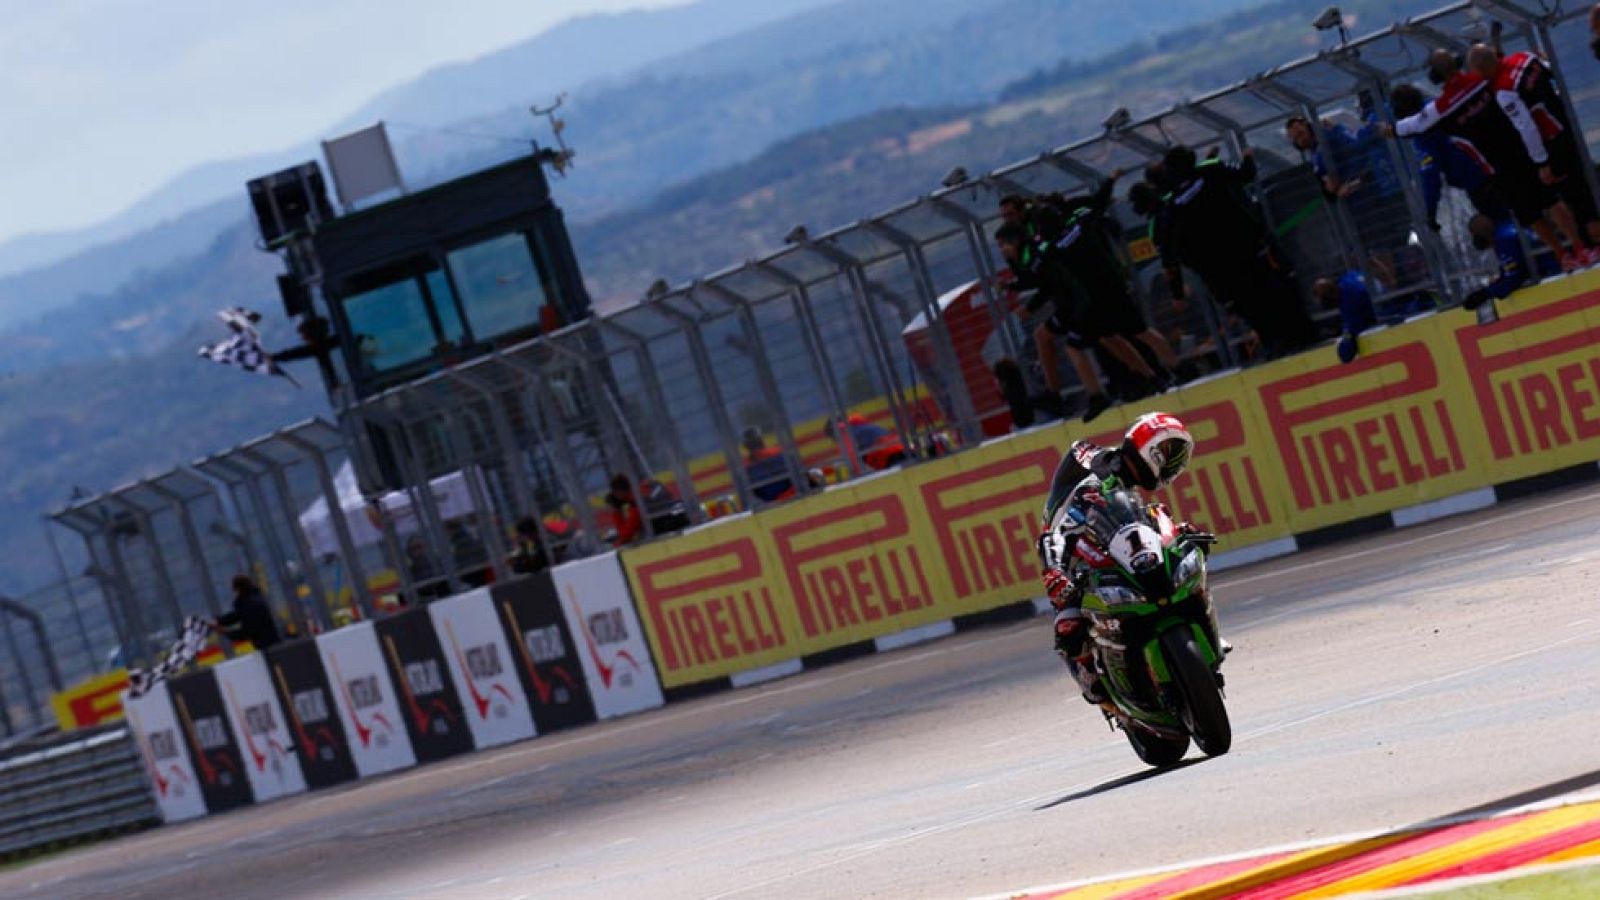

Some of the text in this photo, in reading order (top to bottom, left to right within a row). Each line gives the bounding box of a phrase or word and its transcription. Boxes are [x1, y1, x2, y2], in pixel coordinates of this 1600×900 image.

[1083, 400, 1272, 535] ELLI
[1258, 340, 1467, 511] PIRELLI
[636, 536, 786, 672] PIRELLI
[771, 493, 935, 638] PIRELLI
[1125, 530, 1148, 557] 1
